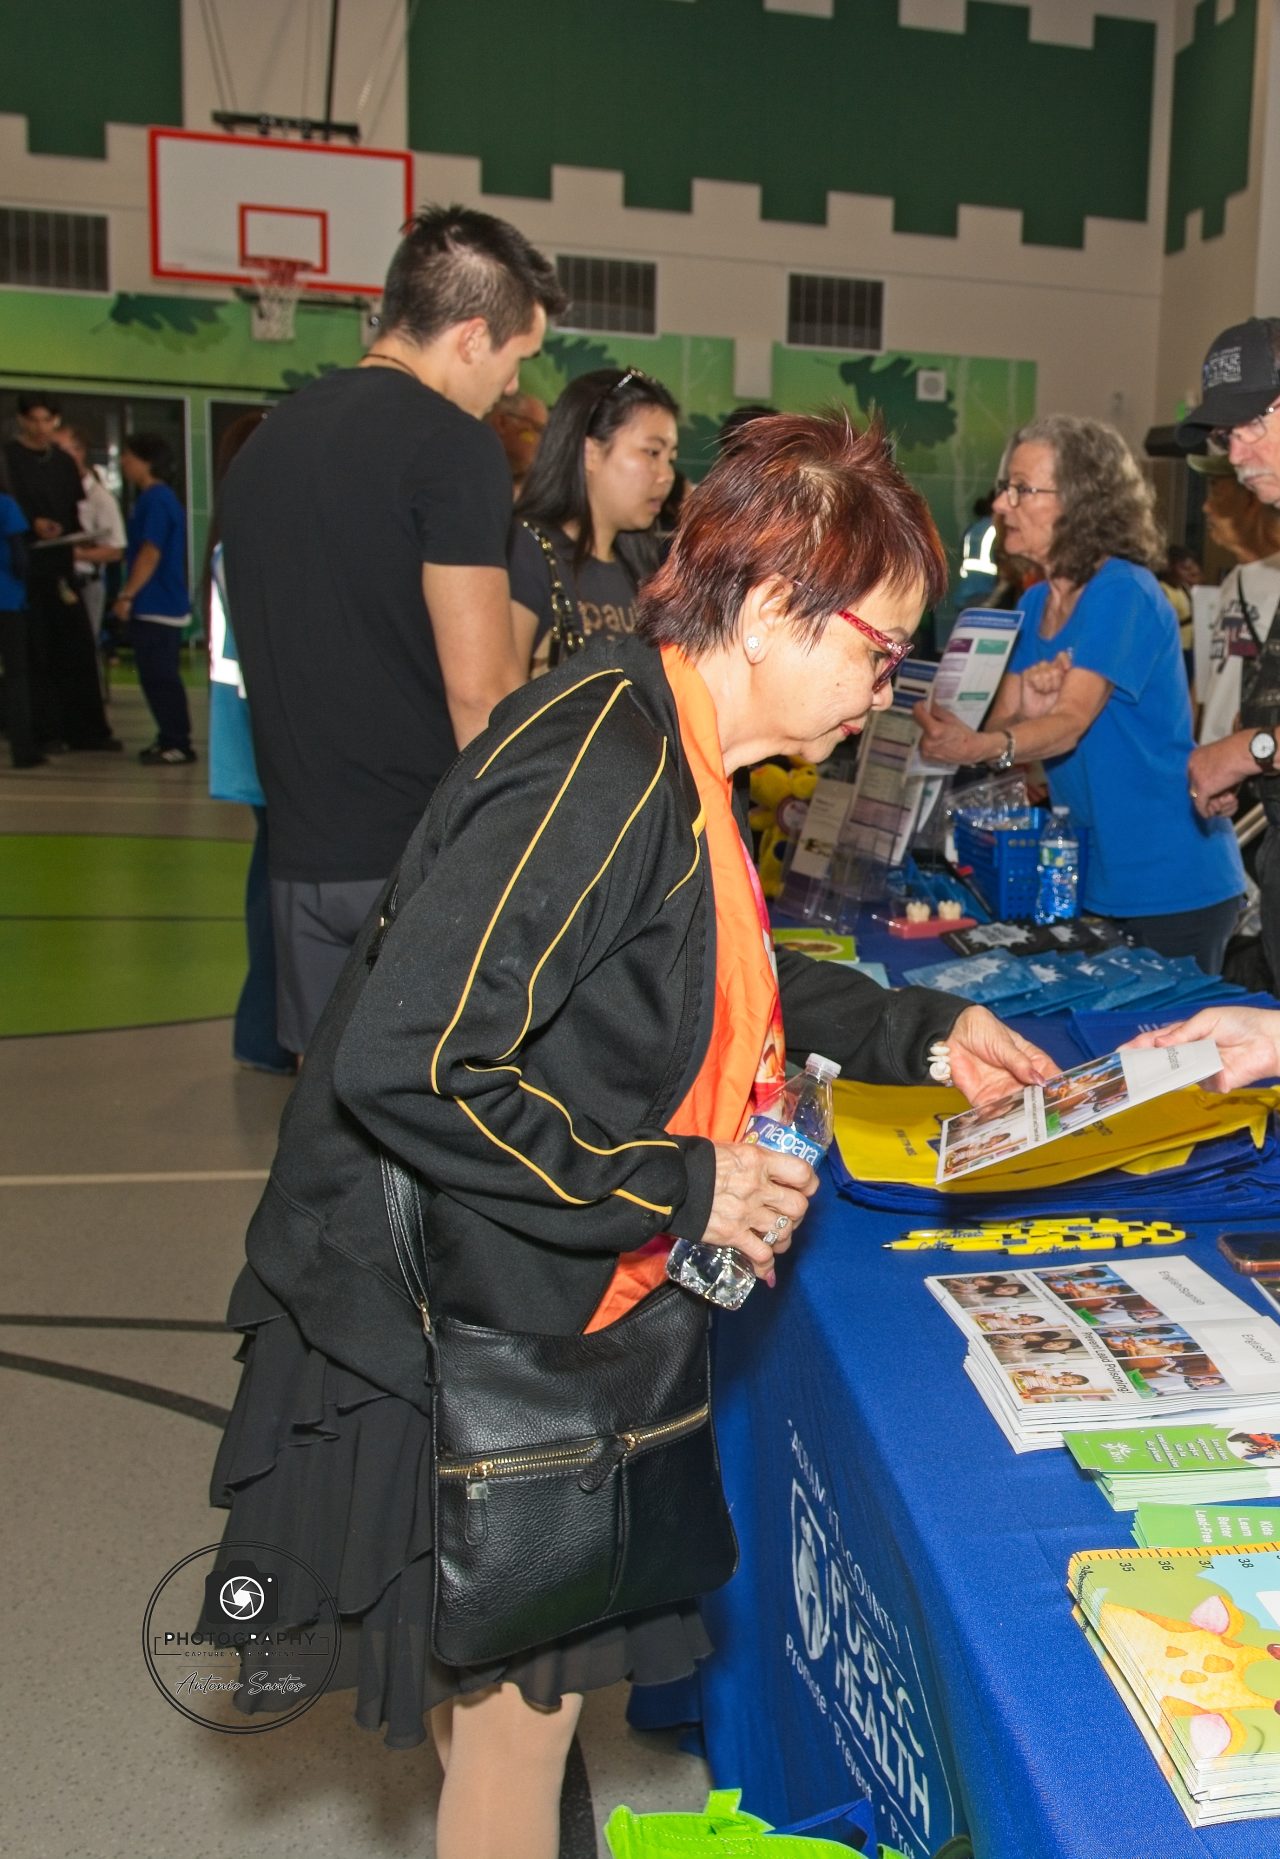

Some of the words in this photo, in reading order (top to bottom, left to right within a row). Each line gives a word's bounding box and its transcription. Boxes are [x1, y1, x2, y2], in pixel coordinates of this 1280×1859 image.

[760, 1122, 818, 1166] niagara
[1104, 1363, 1134, 1394] Poisoning!
[1195, 1510, 1213, 1544] Lead-Free
[1216, 1516, 1233, 1538] Better
[1238, 1518, 1252, 1538] Learn
[1258, 1520, 1274, 1537] Kids
[1120, 1562, 1136, 1572] 35
[1158, 1560, 1174, 1571] 36
[1199, 1560, 1214, 1570] 37
[1238, 1558, 1254, 1570] 38
[786, 1632, 827, 1714] Promote
[834, 1721, 872, 1801] Prevent
[832, 1628, 931, 1840] HEALTH
